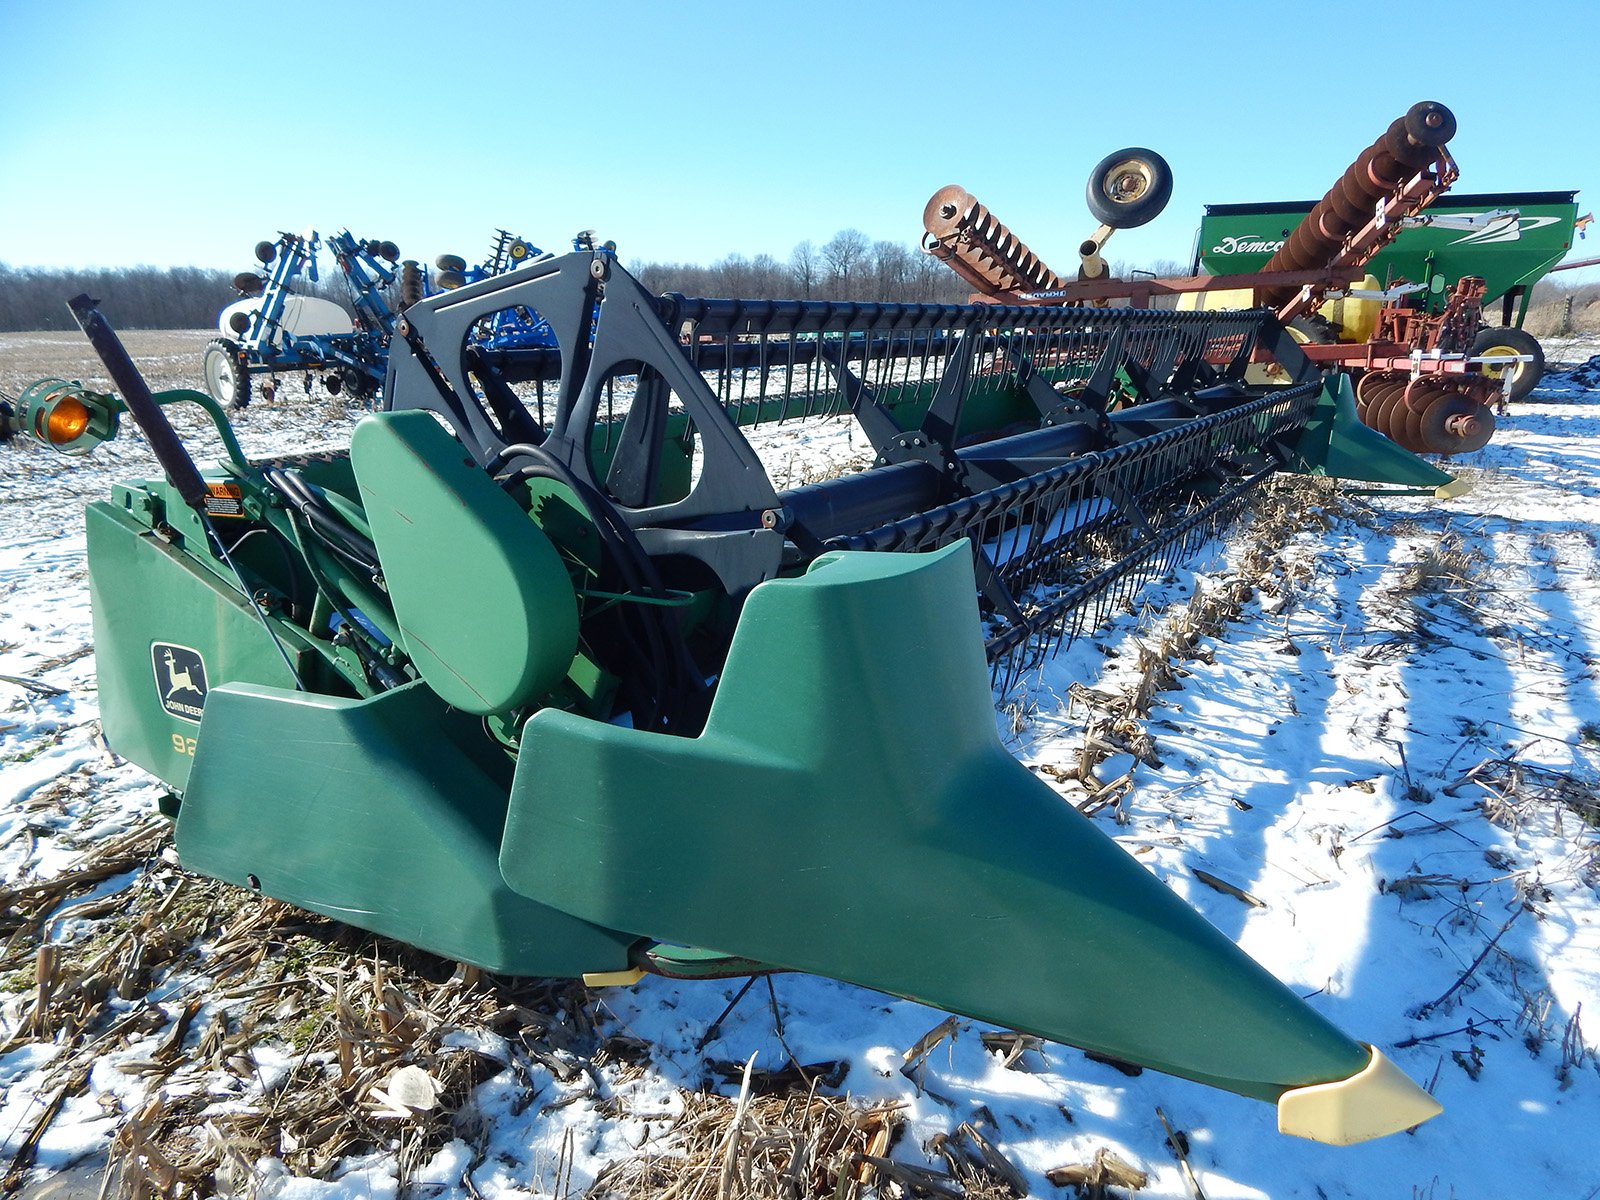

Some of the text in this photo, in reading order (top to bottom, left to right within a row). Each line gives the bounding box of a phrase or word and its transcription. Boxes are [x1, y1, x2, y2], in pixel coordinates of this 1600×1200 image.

[1213, 235, 1285, 255] Demco
[165, 700, 203, 717] JOHN DEER
